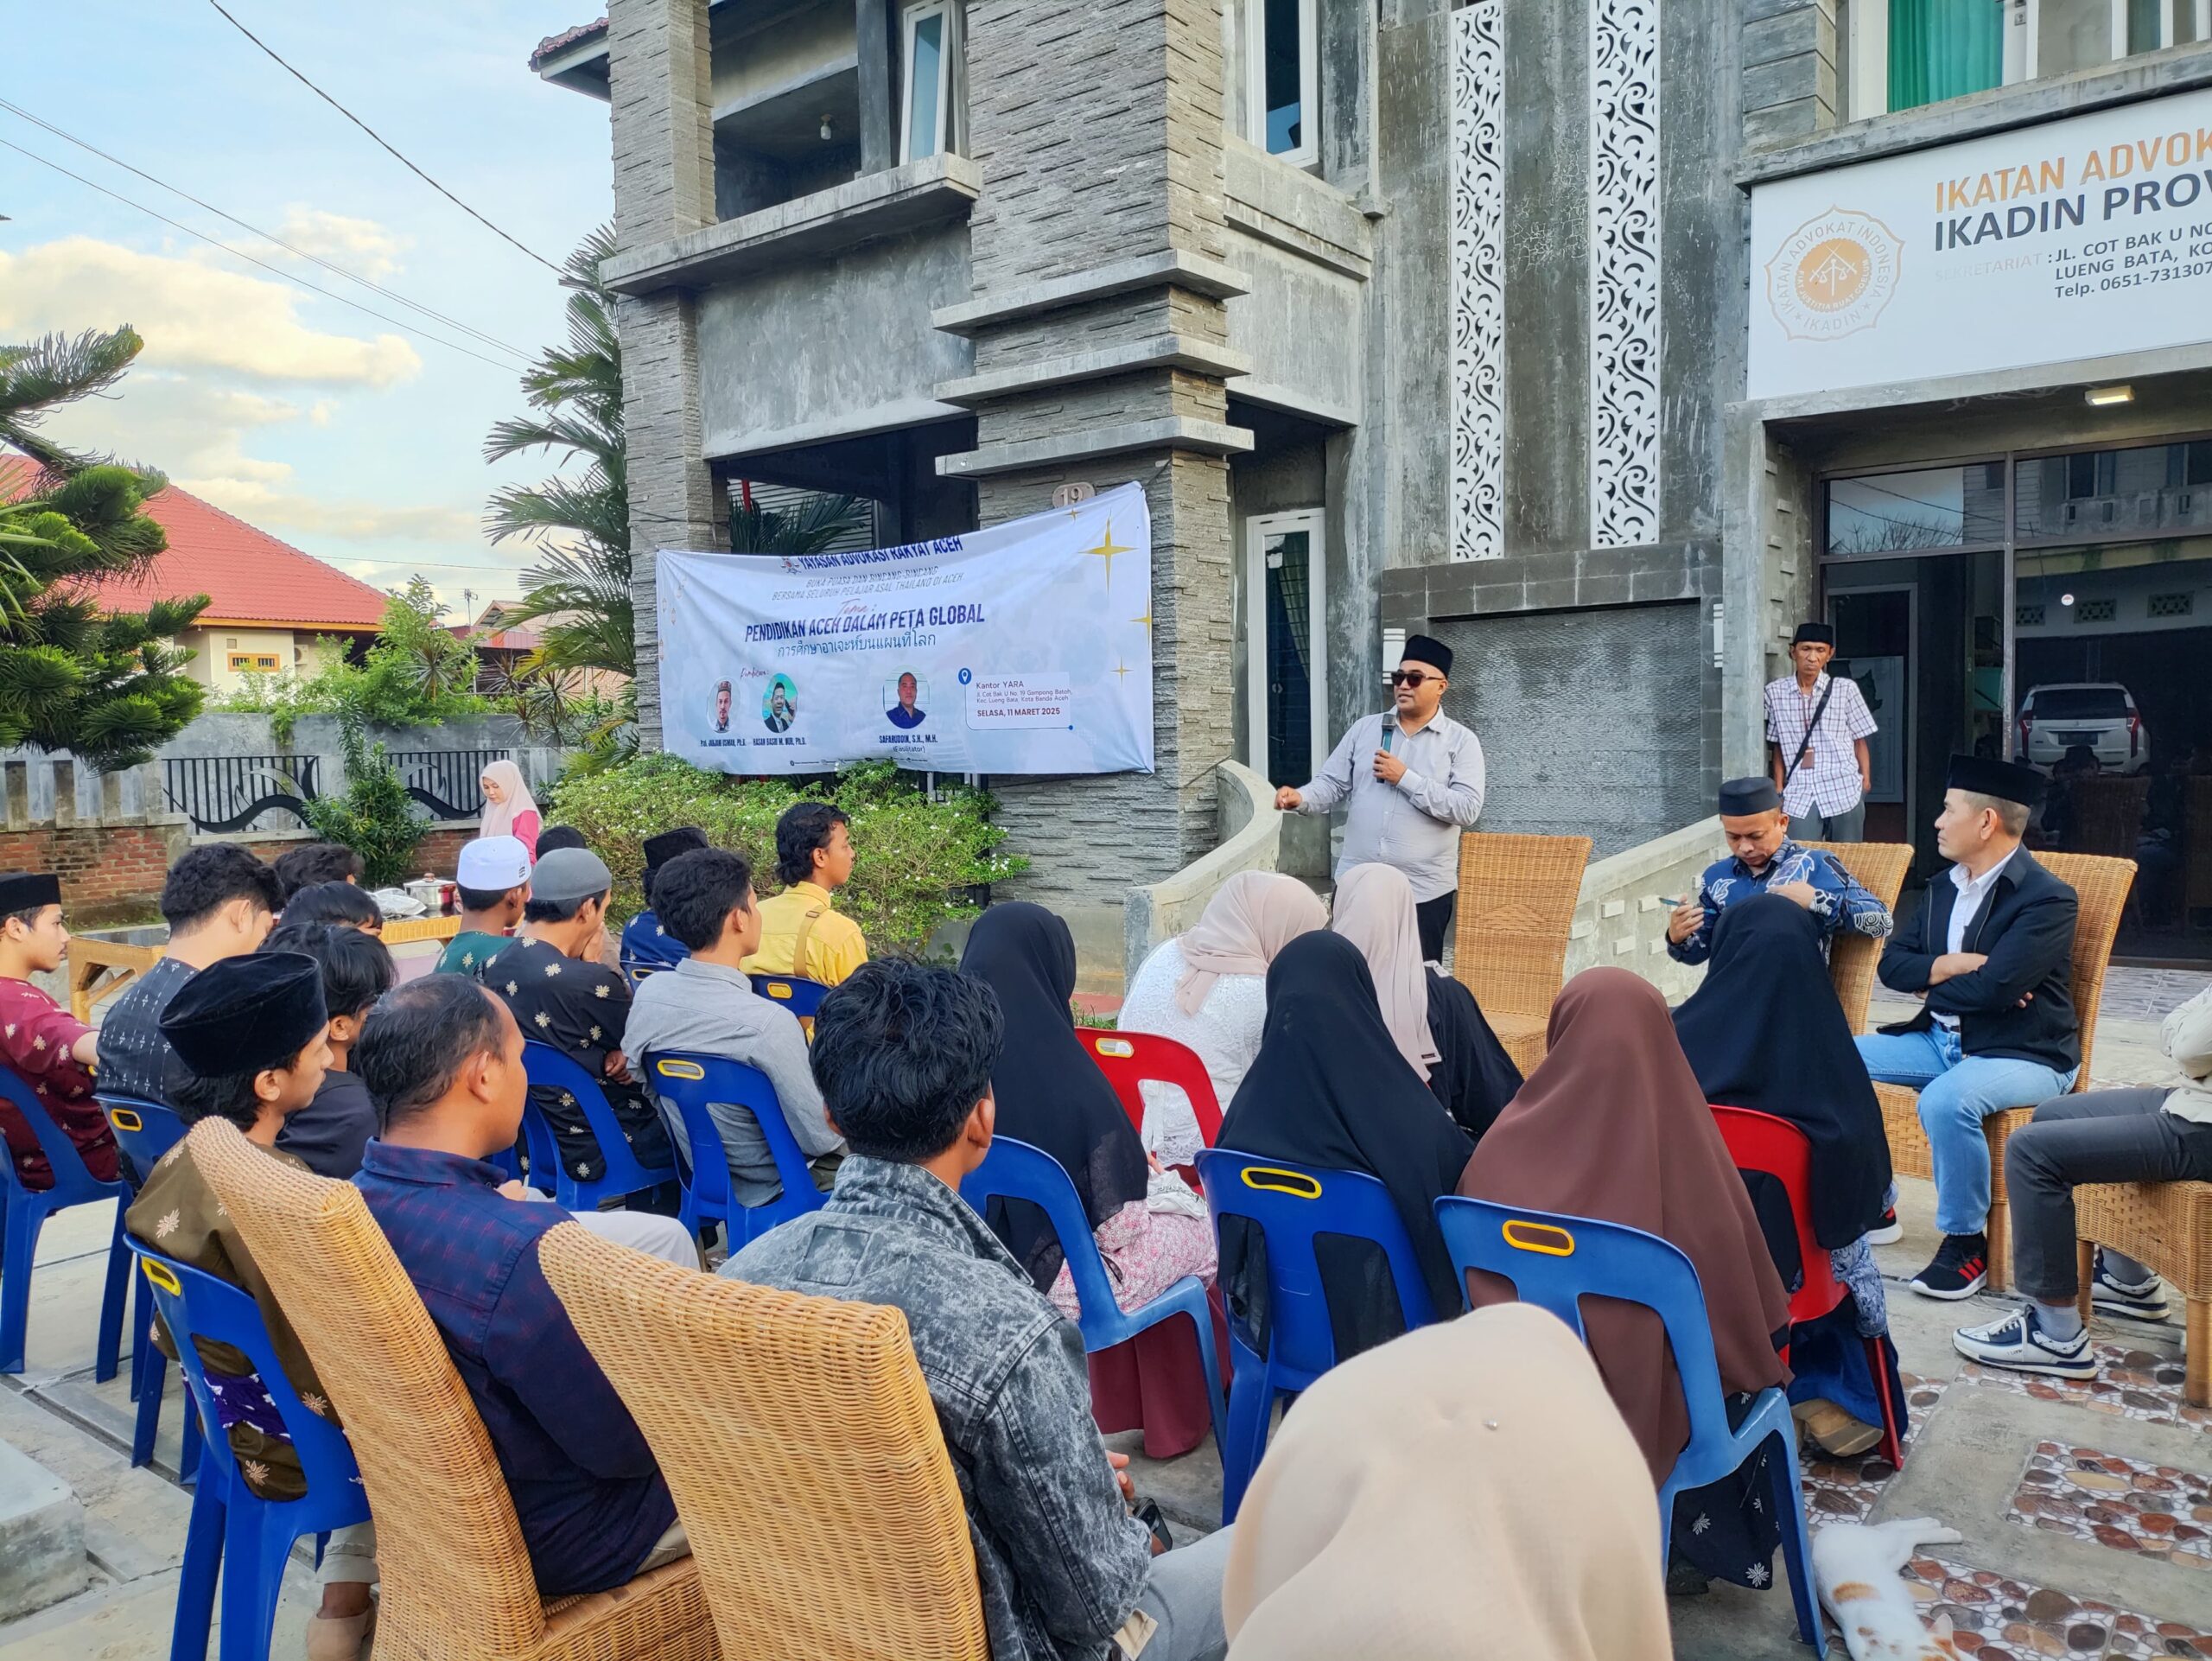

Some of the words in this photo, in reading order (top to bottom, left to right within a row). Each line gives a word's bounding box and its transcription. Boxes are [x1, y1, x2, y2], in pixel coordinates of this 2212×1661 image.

[1936, 156, 2065, 213] IKATAN
[2079, 128, 2212, 186] ADVOK
[1936, 194, 2085, 251] IKADIN
[1777, 262, 1796, 315] IKATAN
[1789, 221, 1856, 260] ADVOKAT
[1856, 224, 1891, 298] INDONESIA
[1935, 252, 2043, 283] SEKRETARIAT
[2083, 239, 2120, 258] COT
[2126, 231, 2162, 250] BAK
[2169, 227, 2183, 242] U
[2056, 259, 2114, 280] LUENG
[2124, 249, 2178, 269] BATA,
[2189, 241, 2212, 258] KO
[2055, 283, 2094, 298] Telp.
[1803, 309, 1861, 333] IKADIN
[1061, 487, 1084, 506] 19
[798, 555, 842, 570] YAYASAN
[933, 536, 963, 554] ACEH
[772, 589, 805, 601] BERSAMA
[875, 582, 893, 593] ASAL
[943, 572, 965, 584] ACEH
[745, 620, 806, 642] PENDIDIKAN
[809, 616, 842, 637] ACEH
[842, 611, 887, 633] DALAM
[889, 608, 925, 629] PETA
[929, 603, 985, 627] GLOBAL
[977, 709, 1006, 717] SELASA,
[1041, 707, 1060, 716] 2025
